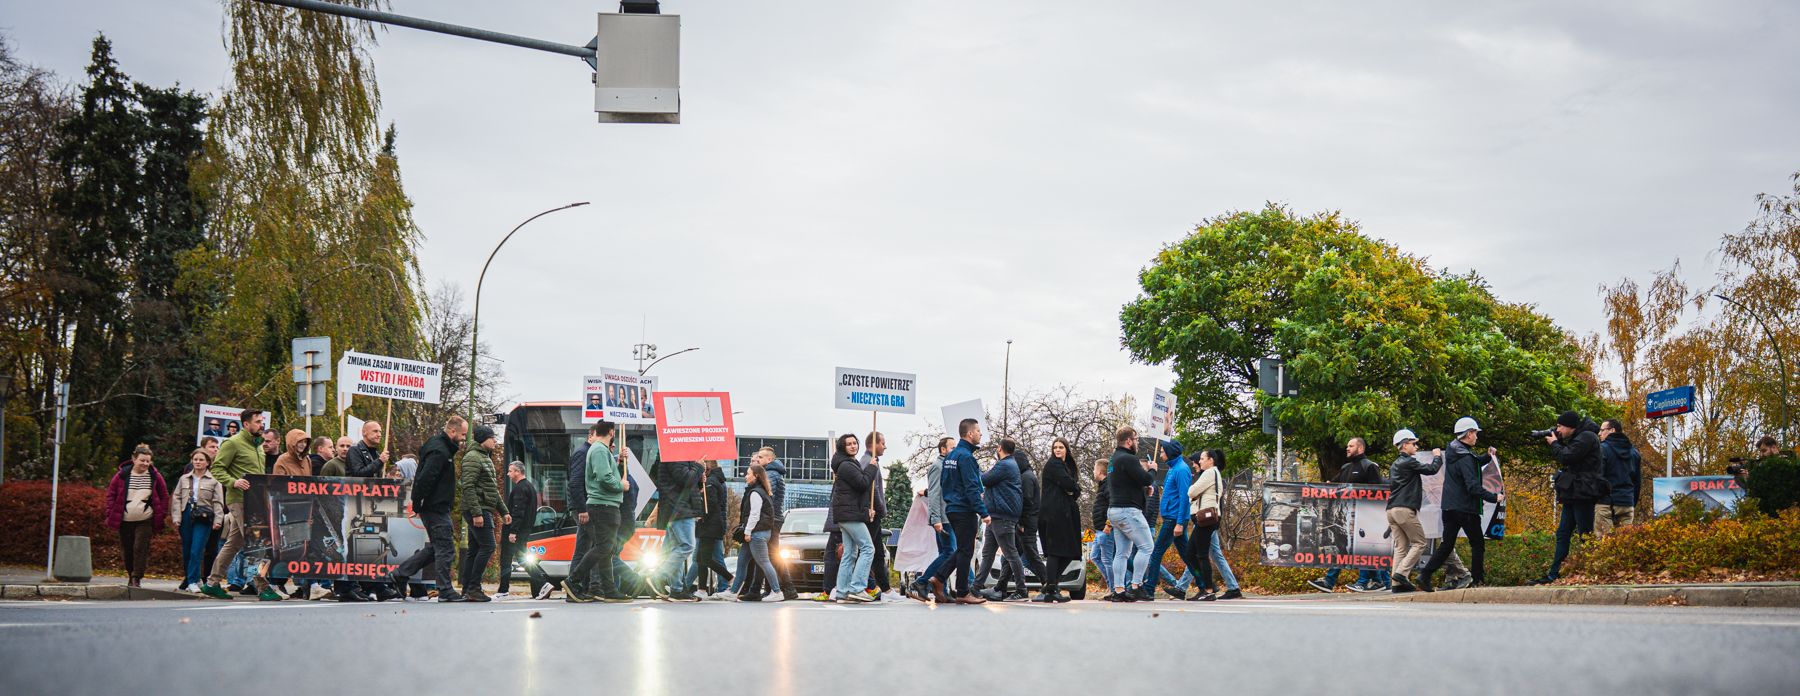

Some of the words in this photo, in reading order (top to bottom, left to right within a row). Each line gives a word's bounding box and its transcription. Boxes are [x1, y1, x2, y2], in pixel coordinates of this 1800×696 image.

[348, 356, 371, 367] ZMIANA
[372, 360, 392, 370] ZASAD
[394, 362, 400, 371] W
[401, 363, 426, 374] TRAKCIE
[426, 367, 438, 376] GRY
[360, 370, 390, 384] WSTYD
[392, 374, 395, 384] I
[397, 374, 424, 388] HAŃBA
[357, 384, 392, 396] POLSKIEGO
[394, 388, 425, 400] SYSTEMU!
[852, 392, 889, 406] NIECZYSTA
[891, 395, 905, 407] GRA
[288, 482, 329, 495] BRAK
[332, 483, 400, 497] ZAPŁATY
[1690, 480, 1724, 491] BRAK
[1728, 480, 1740, 489] Z
[1302, 487, 1337, 499] BRAK
[1341, 488, 1392, 500] ZAPŁAT
[1295, 552, 1314, 563] OD
[1318, 554, 1332, 564] 11
[288, 561, 310, 574] OD
[314, 562, 324, 574] 7
